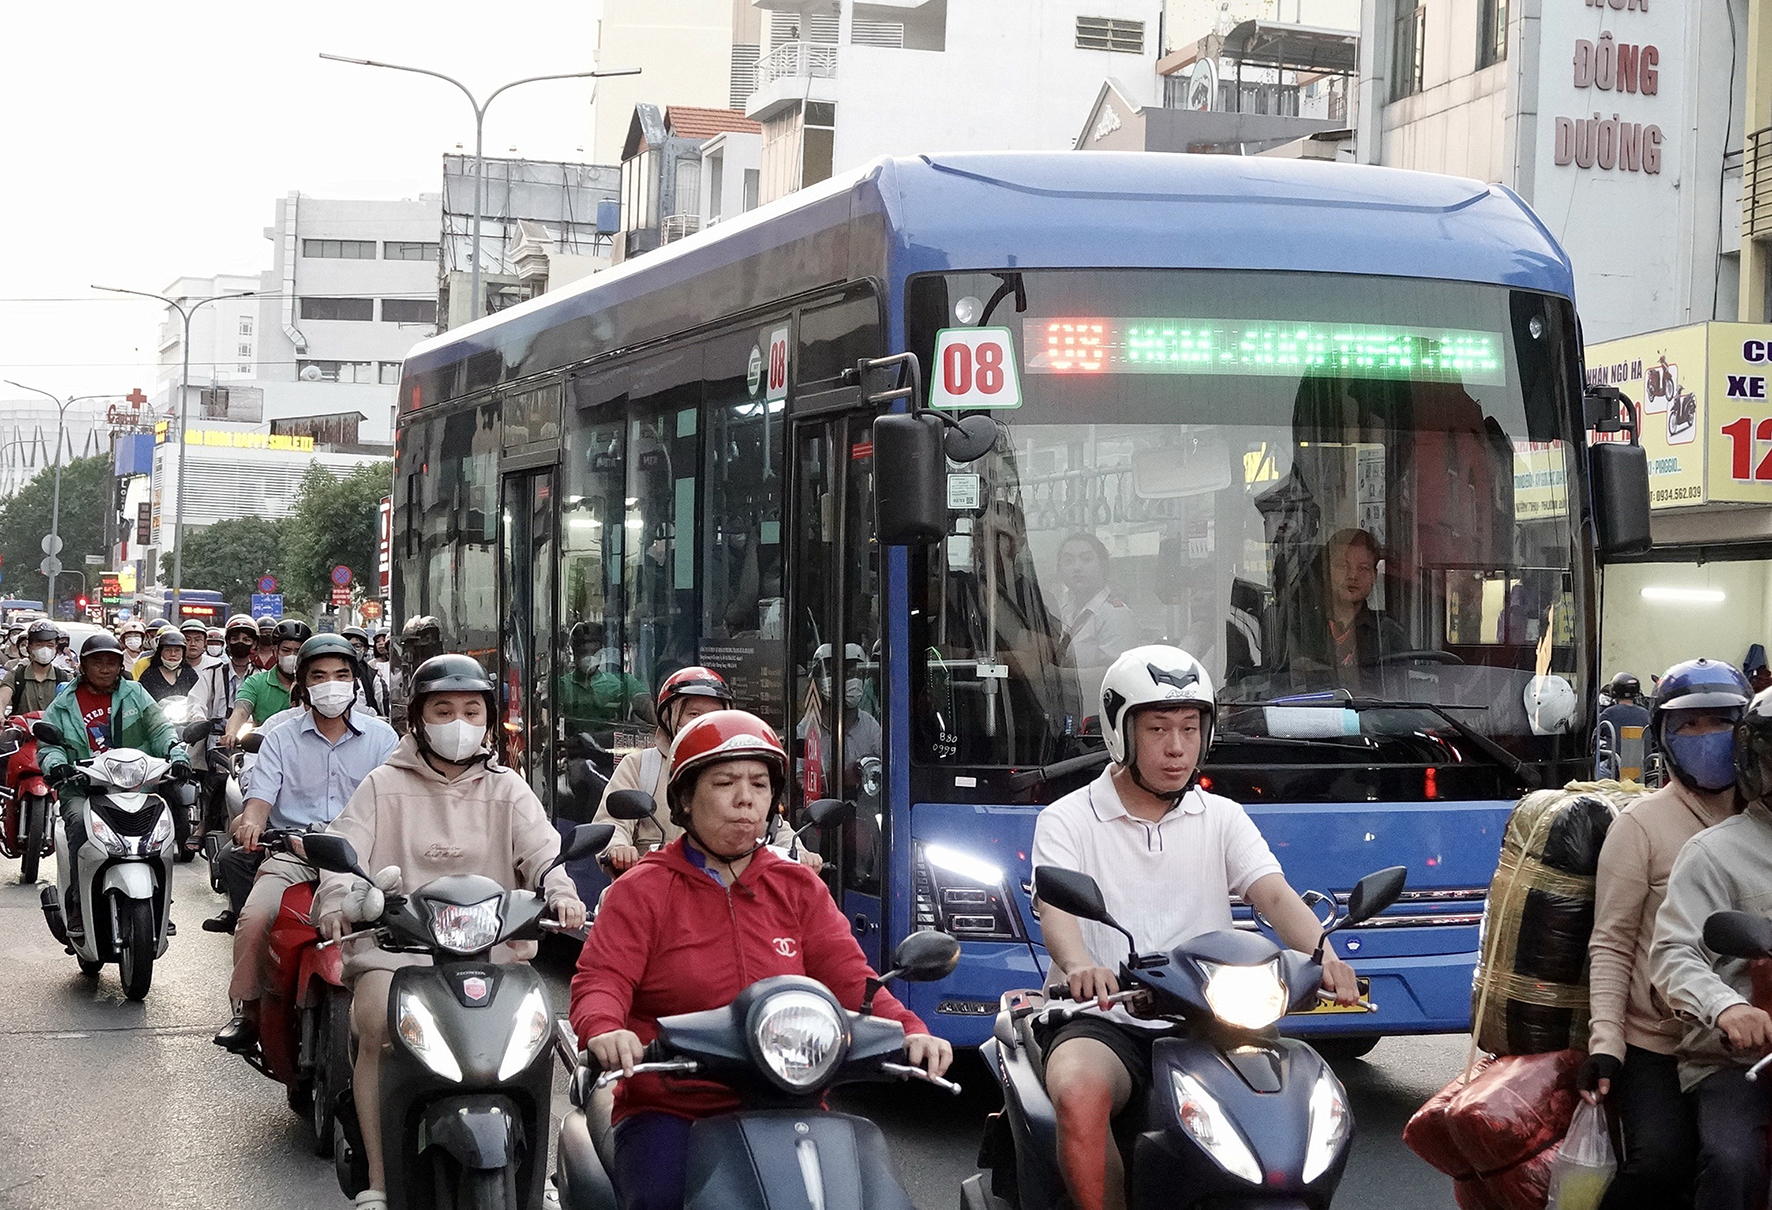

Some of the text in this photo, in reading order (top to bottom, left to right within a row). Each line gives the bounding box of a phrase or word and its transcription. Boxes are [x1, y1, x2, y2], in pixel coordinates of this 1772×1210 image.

[1573, 31, 1659, 95] ĐÔNG
[1555, 112, 1662, 174] DƯƠNG
[770, 340, 785, 390] 08
[943, 342, 1004, 395] 08
[1727, 376, 1765, 398] XE
[1656, 485, 1701, 501] 0934.562.039
[932, 743, 957, 755] 0999
